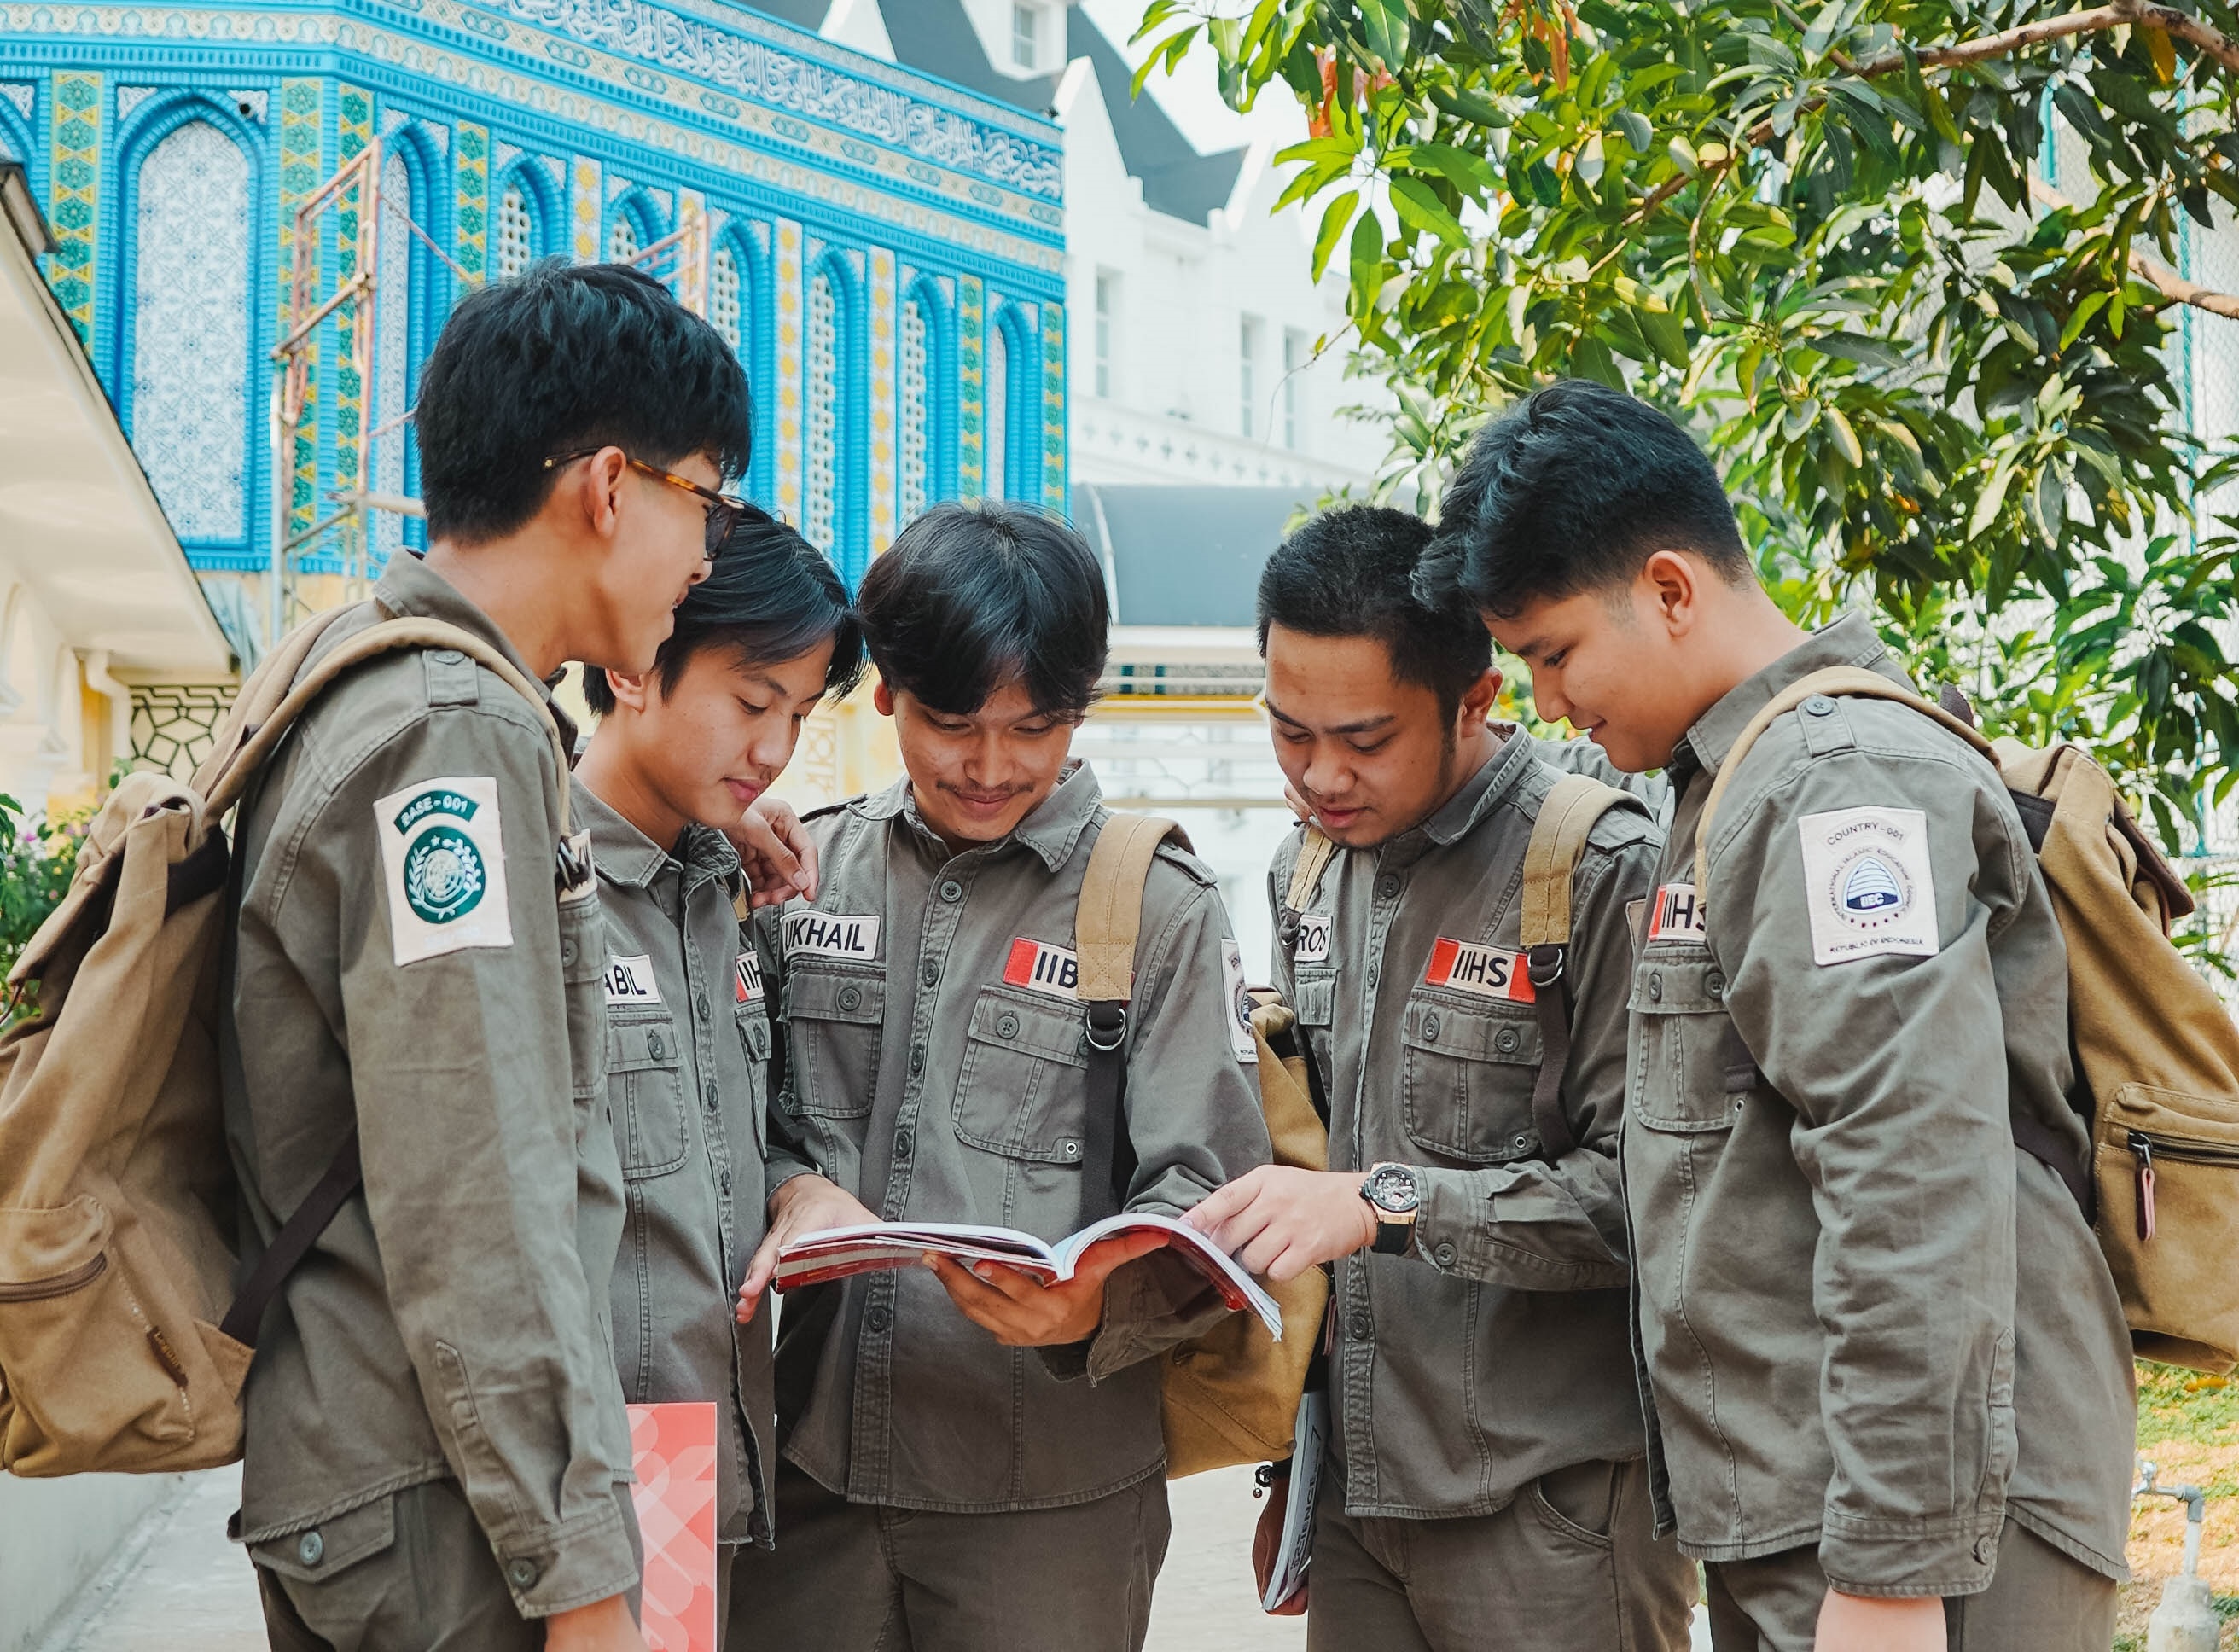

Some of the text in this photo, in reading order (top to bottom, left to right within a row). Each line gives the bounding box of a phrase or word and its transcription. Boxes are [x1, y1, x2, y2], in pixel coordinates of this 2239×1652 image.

[401, 794, 468, 827] BASE-001
[1452, 950, 1509, 987] IIHS
[1311, 1425, 1322, 1448] 7
[1294, 1476, 1317, 1568] SCIENCE
